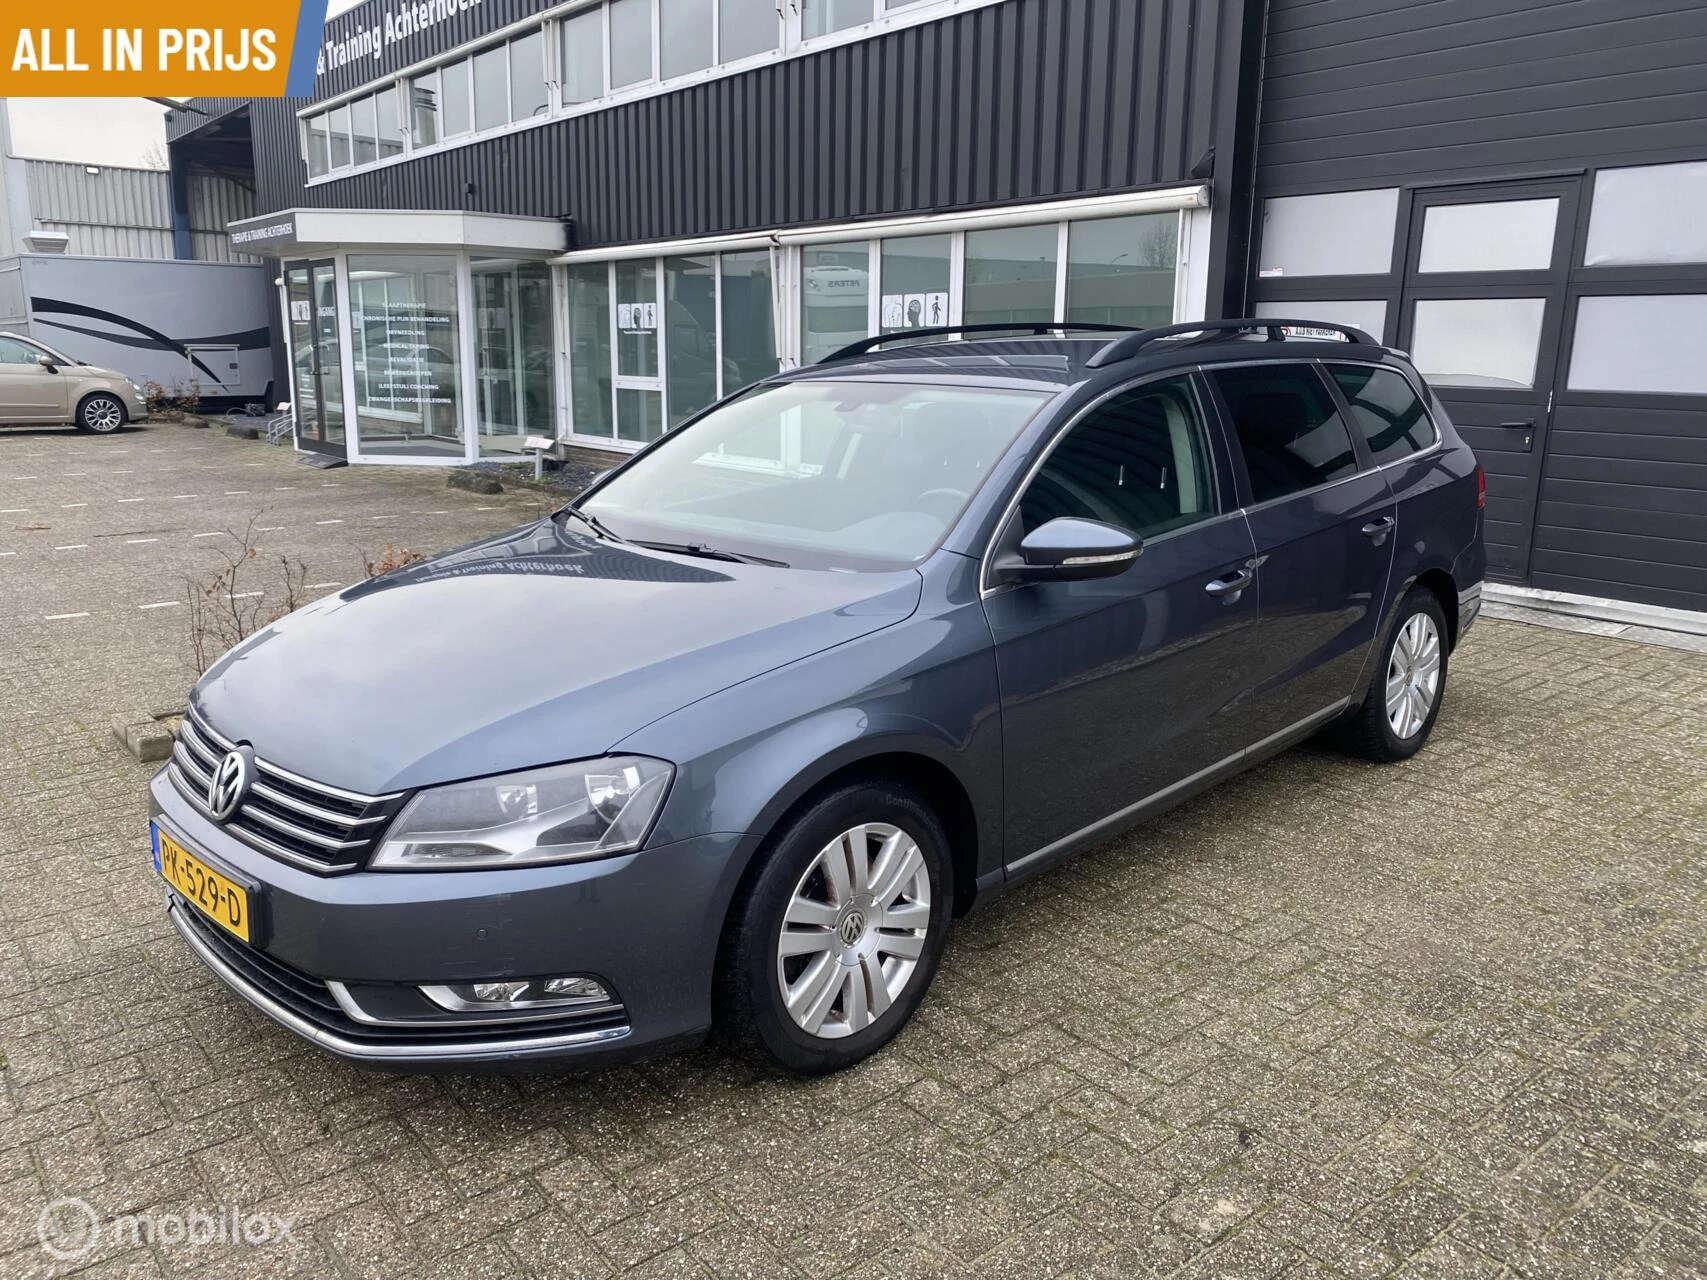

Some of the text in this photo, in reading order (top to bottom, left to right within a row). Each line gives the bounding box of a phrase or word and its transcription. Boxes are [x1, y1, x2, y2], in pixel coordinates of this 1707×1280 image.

[325, 24, 382, 71] Training
[384, 0, 481, 46] Achterho
[160, 837, 242, 928] PK-529-D
